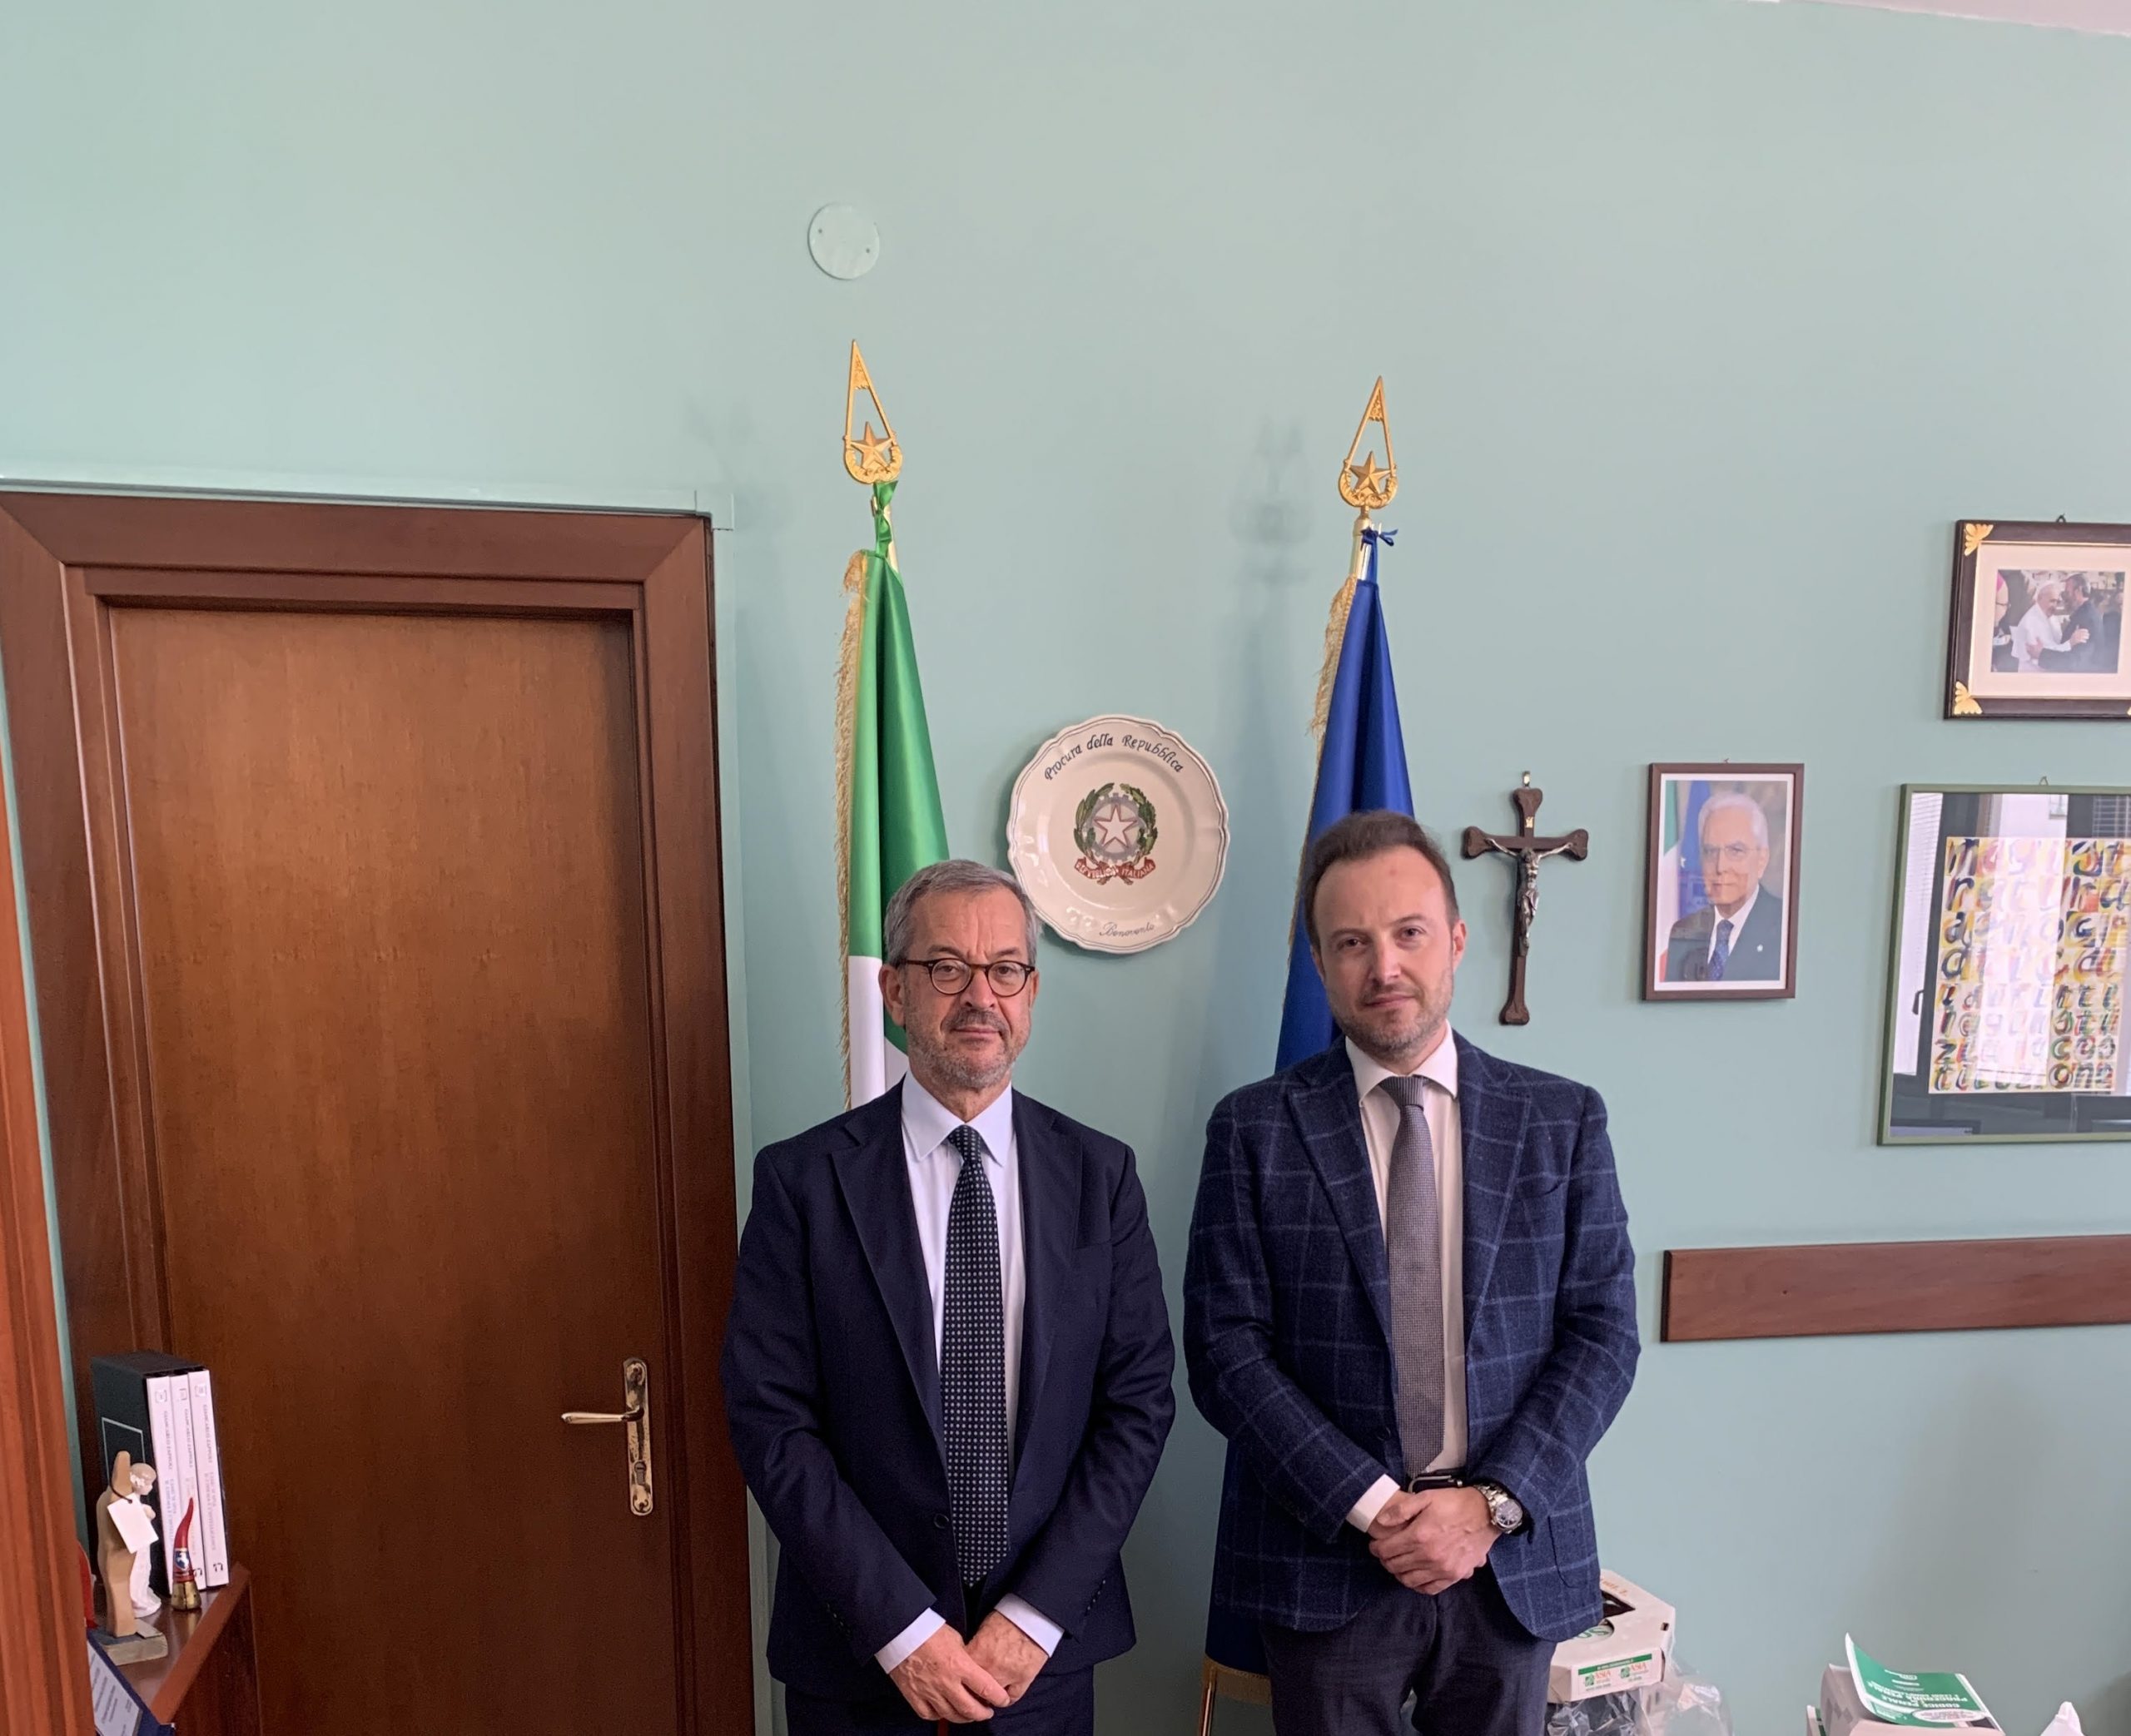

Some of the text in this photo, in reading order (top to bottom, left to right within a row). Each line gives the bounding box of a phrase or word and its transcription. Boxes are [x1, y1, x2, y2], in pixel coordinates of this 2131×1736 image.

[1045, 733, 1184, 781] Procura della Repubblica
